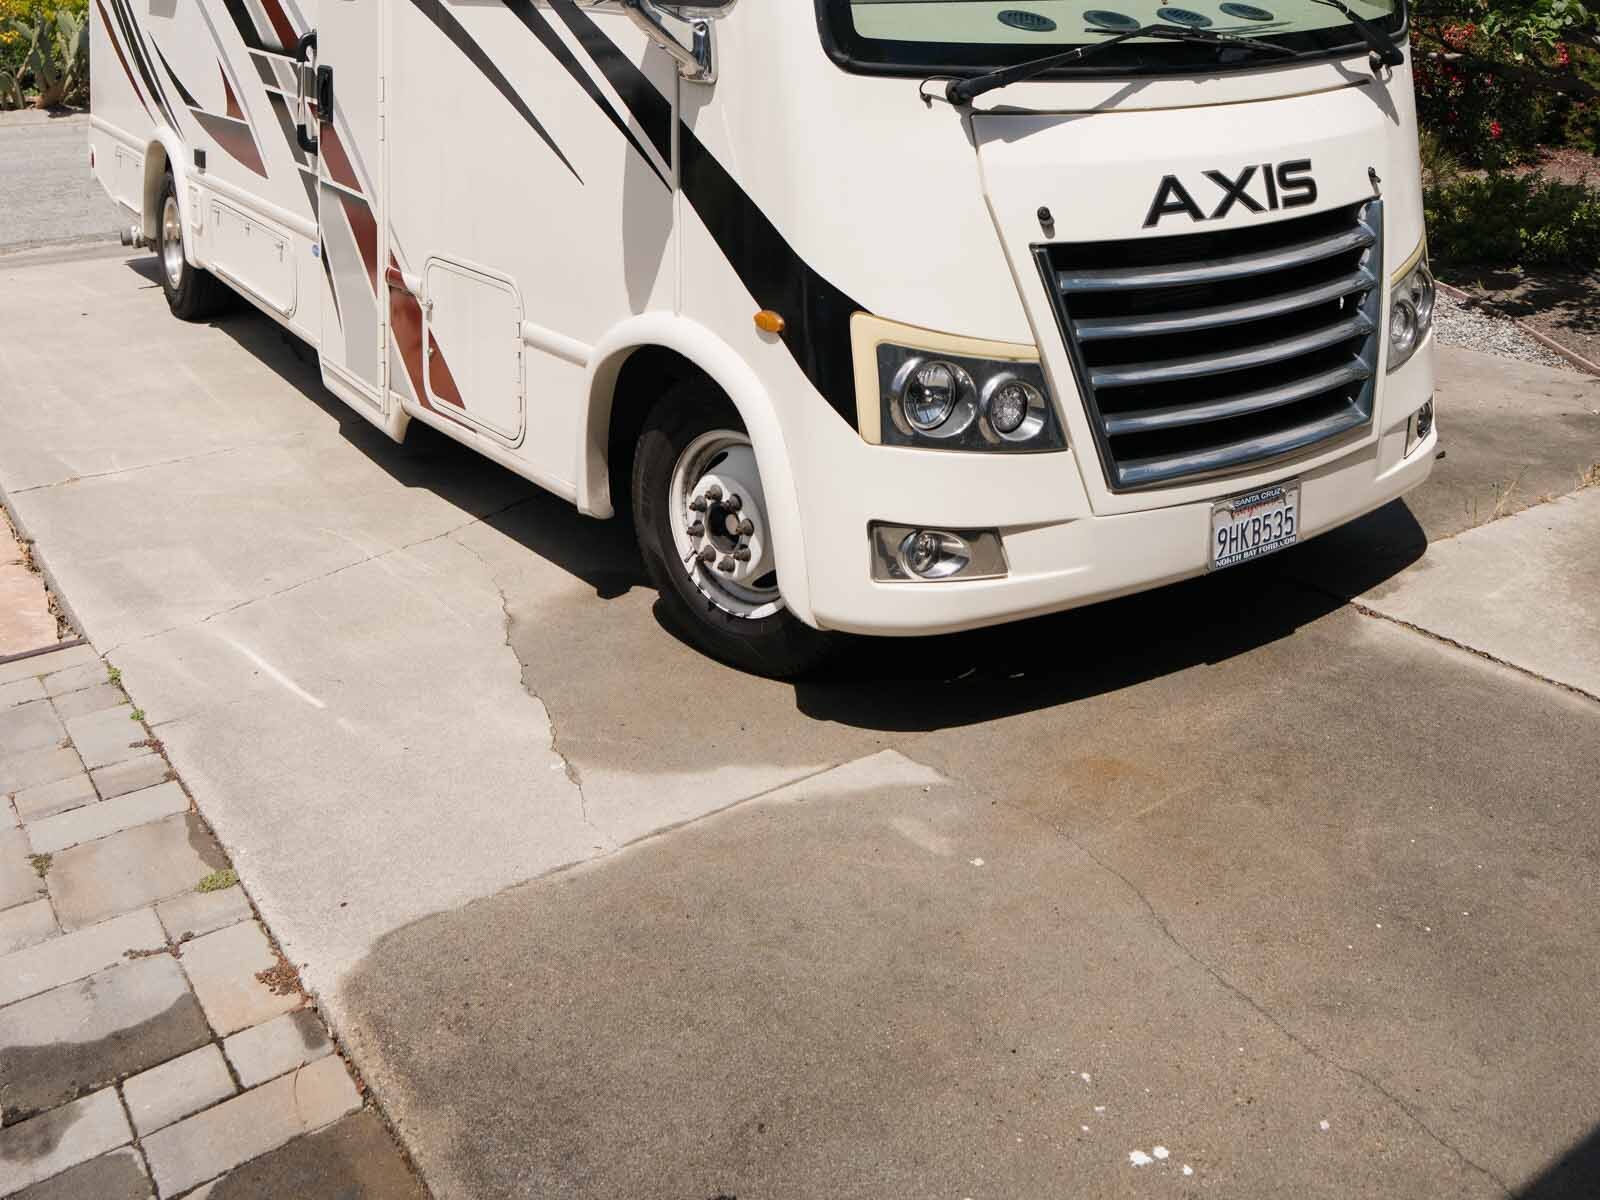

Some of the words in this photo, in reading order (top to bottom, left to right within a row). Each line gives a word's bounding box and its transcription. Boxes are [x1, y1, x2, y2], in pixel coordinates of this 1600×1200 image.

[1142, 158, 1318, 229] AXIS
[1235, 495, 1260, 507] SANTA
[1260, 488, 1281, 499] CRUZ
[1217, 506, 1294, 558] 9HKB535
[1215, 555, 1242, 568] NORTH
[1243, 548, 1258, 560] BAY
